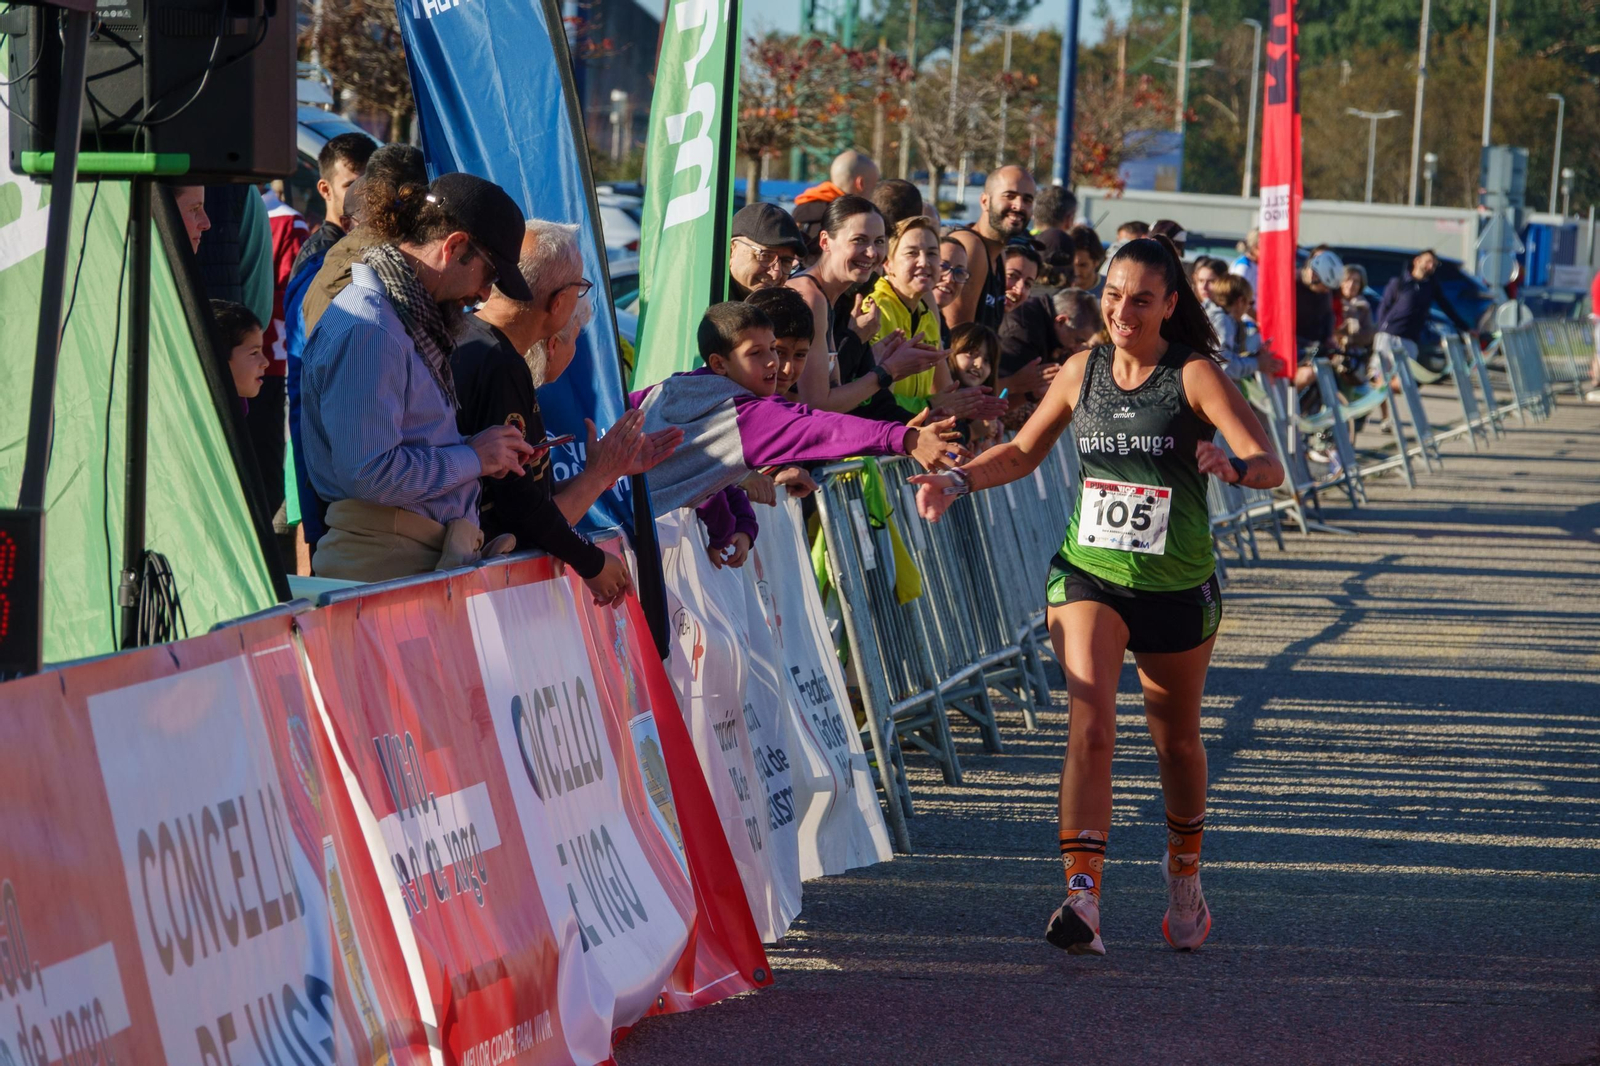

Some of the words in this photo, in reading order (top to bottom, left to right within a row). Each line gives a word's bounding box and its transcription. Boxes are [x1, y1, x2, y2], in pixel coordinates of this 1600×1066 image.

[1079, 431, 1116, 454] máis
[1116, 432, 1130, 455] que
[1130, 435, 1175, 456] auga
[1093, 499, 1152, 531] 105
[443, 823, 489, 908] xogo
[568, 824, 649, 939] VIGO
[490, 1026, 516, 1066] CIDADE
[515, 1019, 535, 1055] PARA
[533, 1009, 554, 1045] VIVIR
